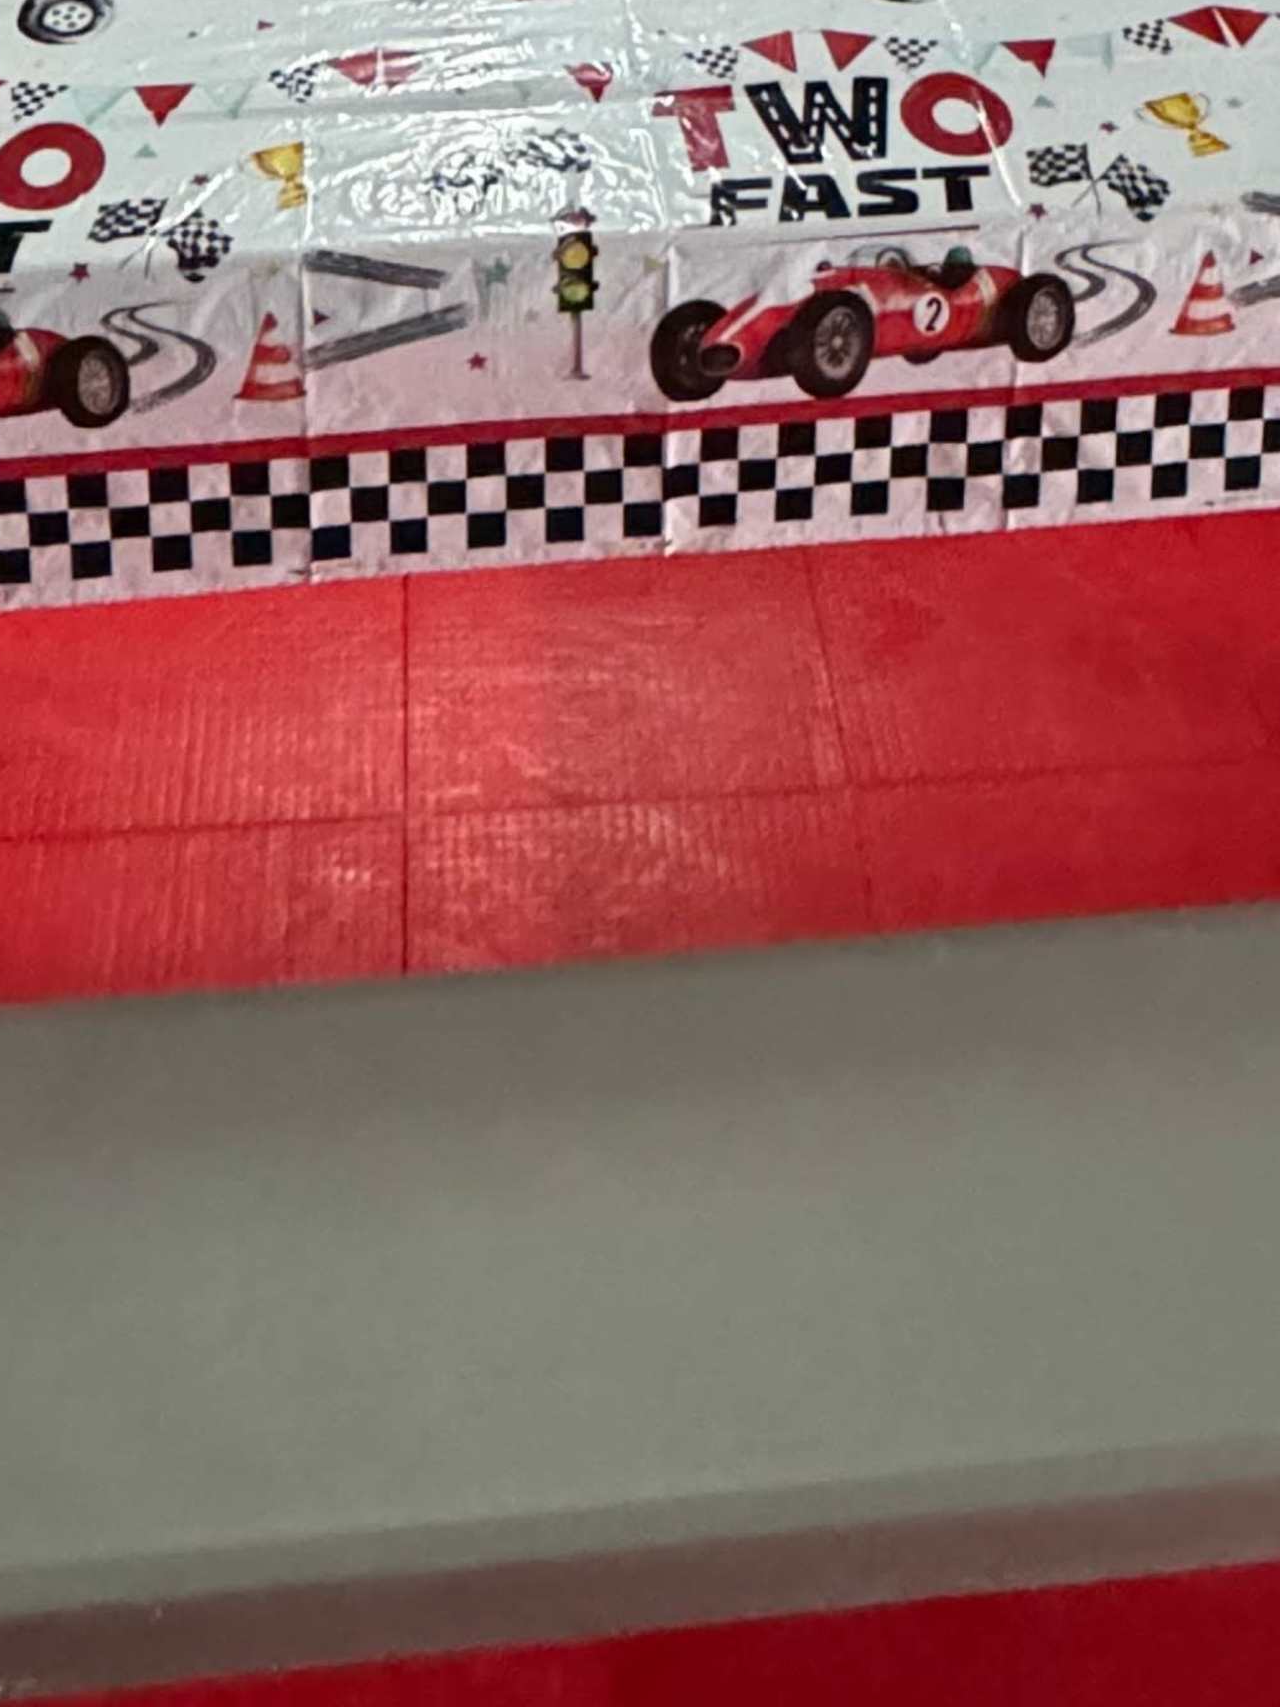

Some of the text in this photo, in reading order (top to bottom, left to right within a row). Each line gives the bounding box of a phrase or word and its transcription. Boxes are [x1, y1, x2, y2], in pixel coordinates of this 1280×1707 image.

[651, 71, 1013, 172] TWO
[710, 165, 990, 227] FAST
[925, 297, 942, 331] 2
